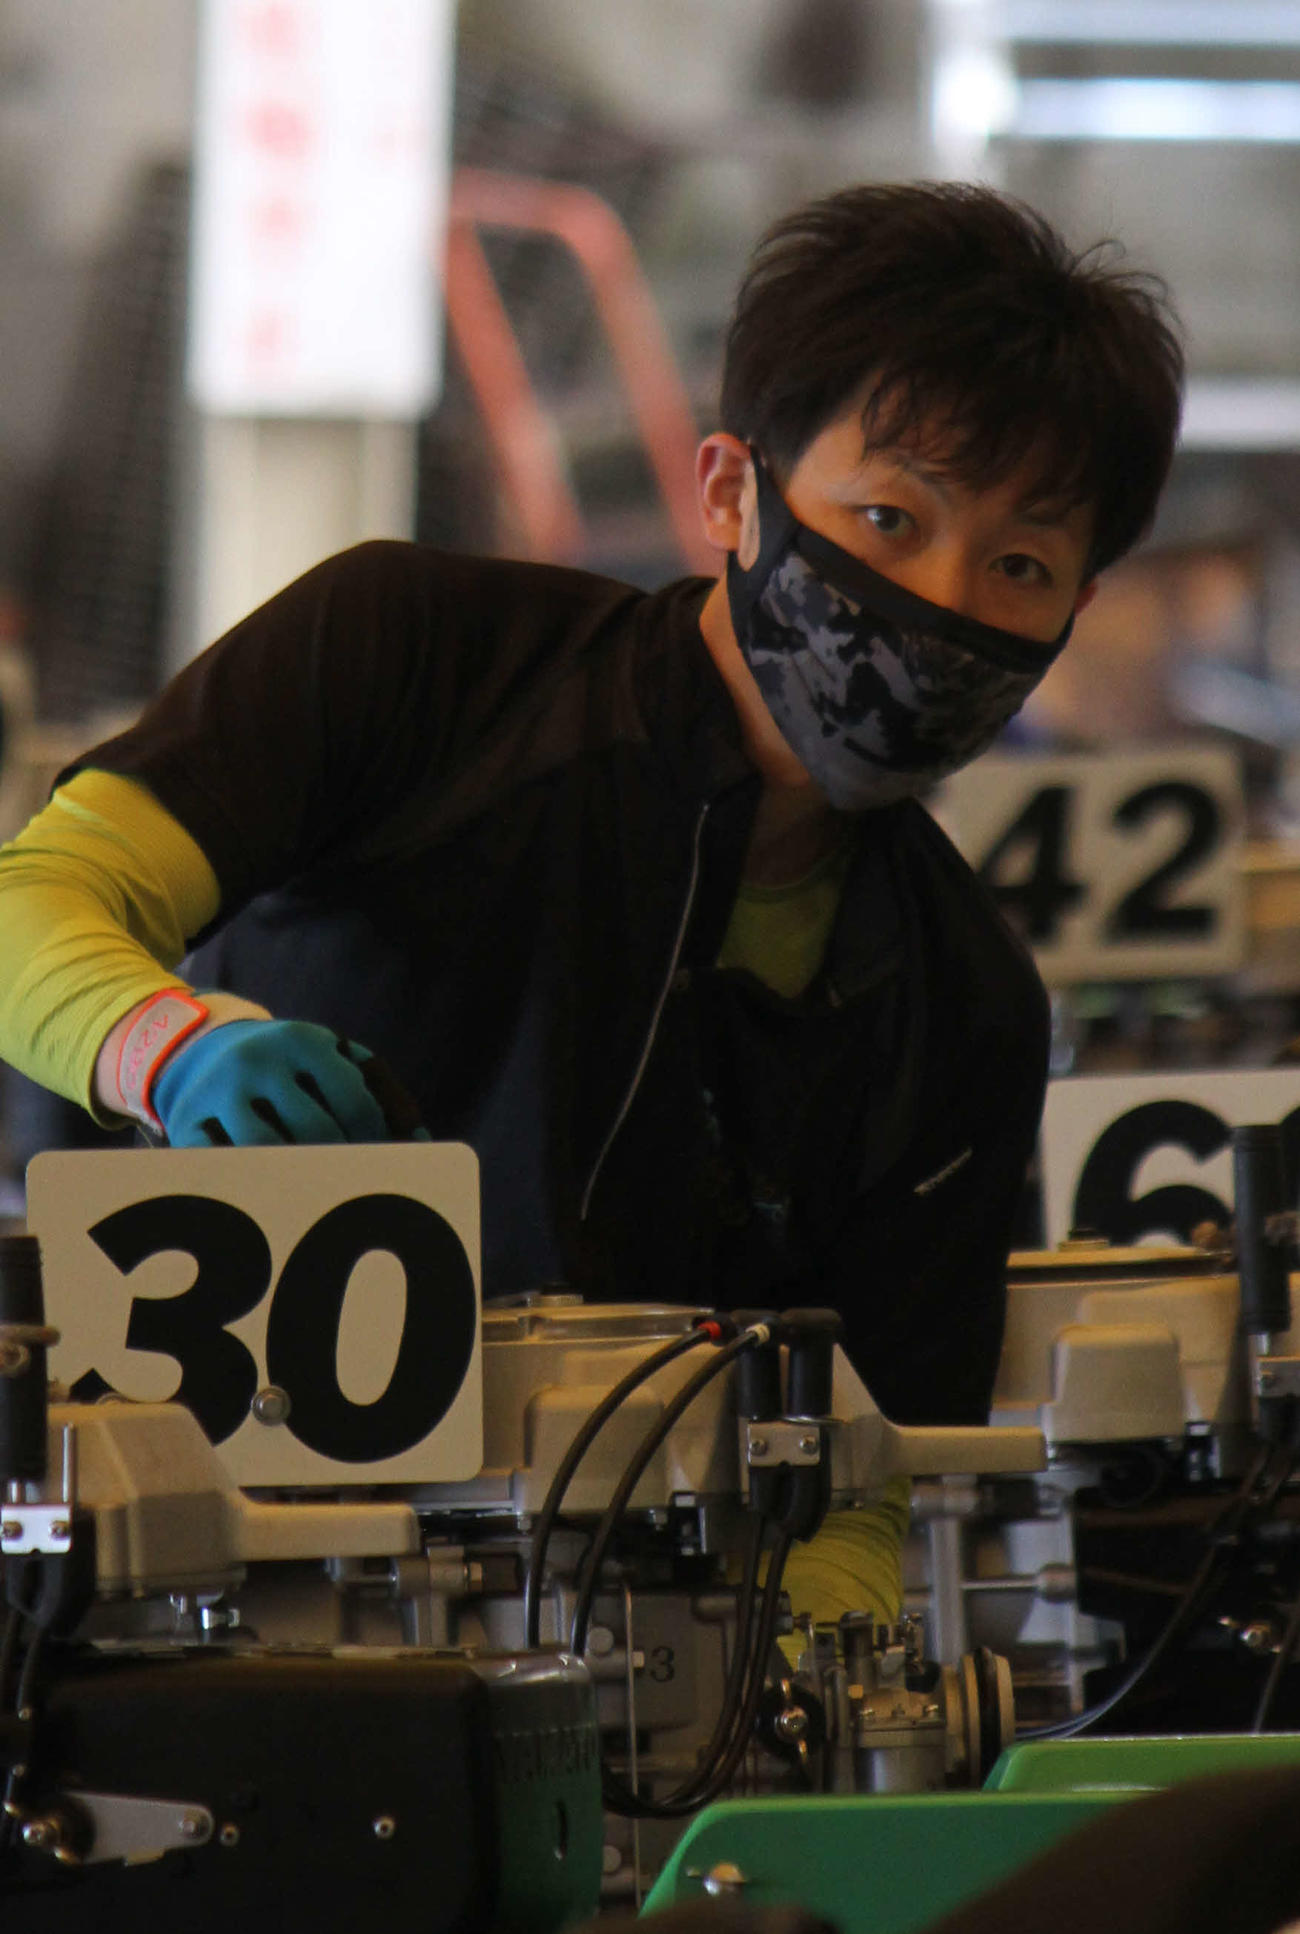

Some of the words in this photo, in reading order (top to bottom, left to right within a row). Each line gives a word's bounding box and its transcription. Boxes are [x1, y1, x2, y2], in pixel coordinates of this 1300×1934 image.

[982, 781, 1222, 942] 42
[1073, 1099, 1300, 1247] 6
[70, 1193, 476, 1464] 30
[651, 1646, 675, 1682] 3
